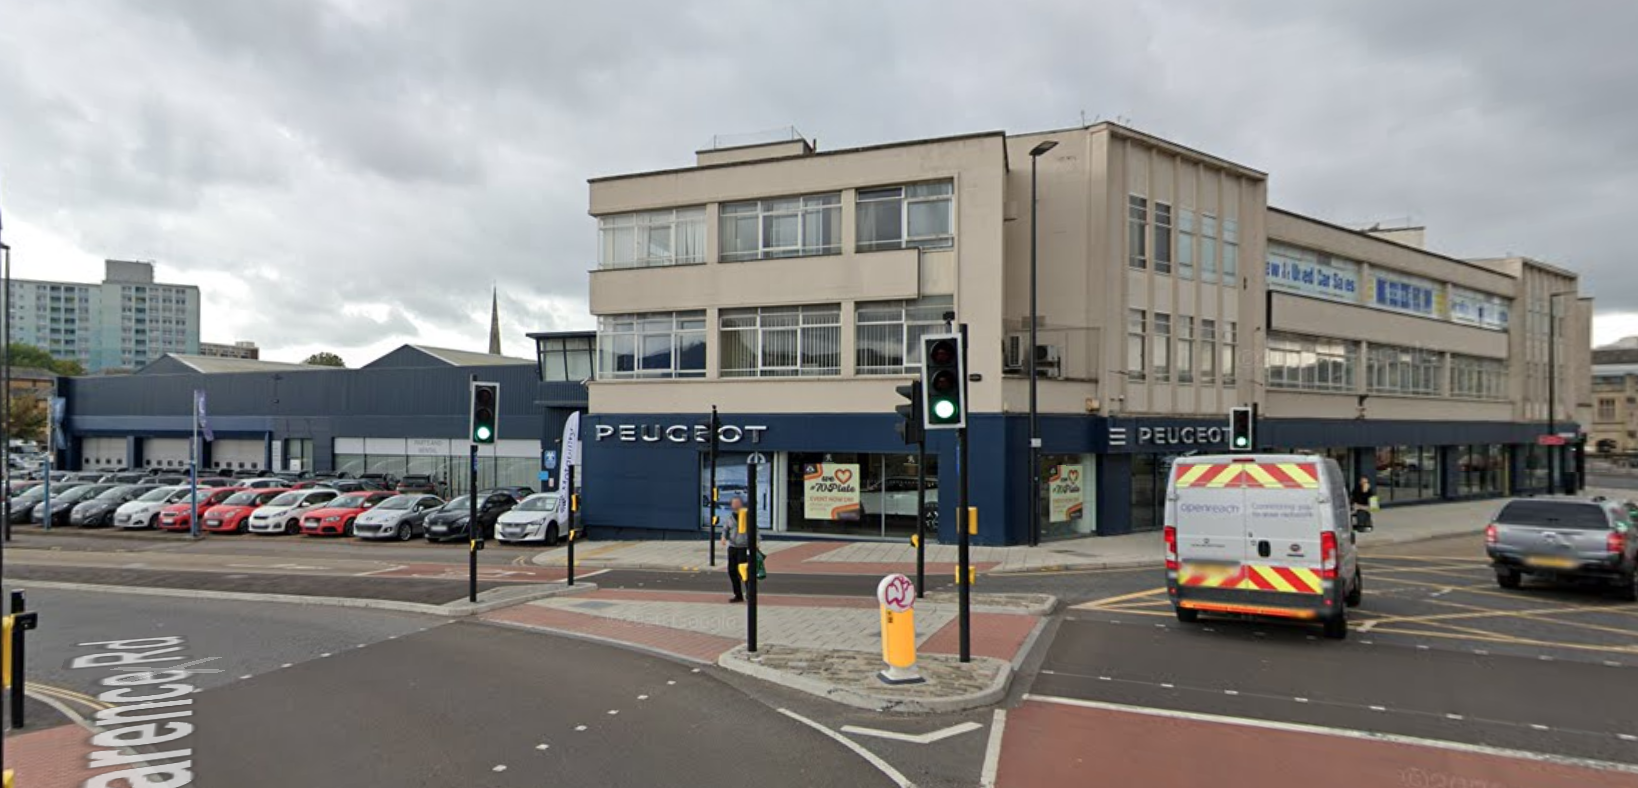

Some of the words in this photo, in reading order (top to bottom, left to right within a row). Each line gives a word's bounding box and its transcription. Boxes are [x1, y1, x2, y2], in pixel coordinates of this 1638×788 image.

[595, 424, 767, 443] PEUGEOT
[1139, 426, 1231, 445] PEUGEOT
[1180, 502, 1240, 514] openreach
